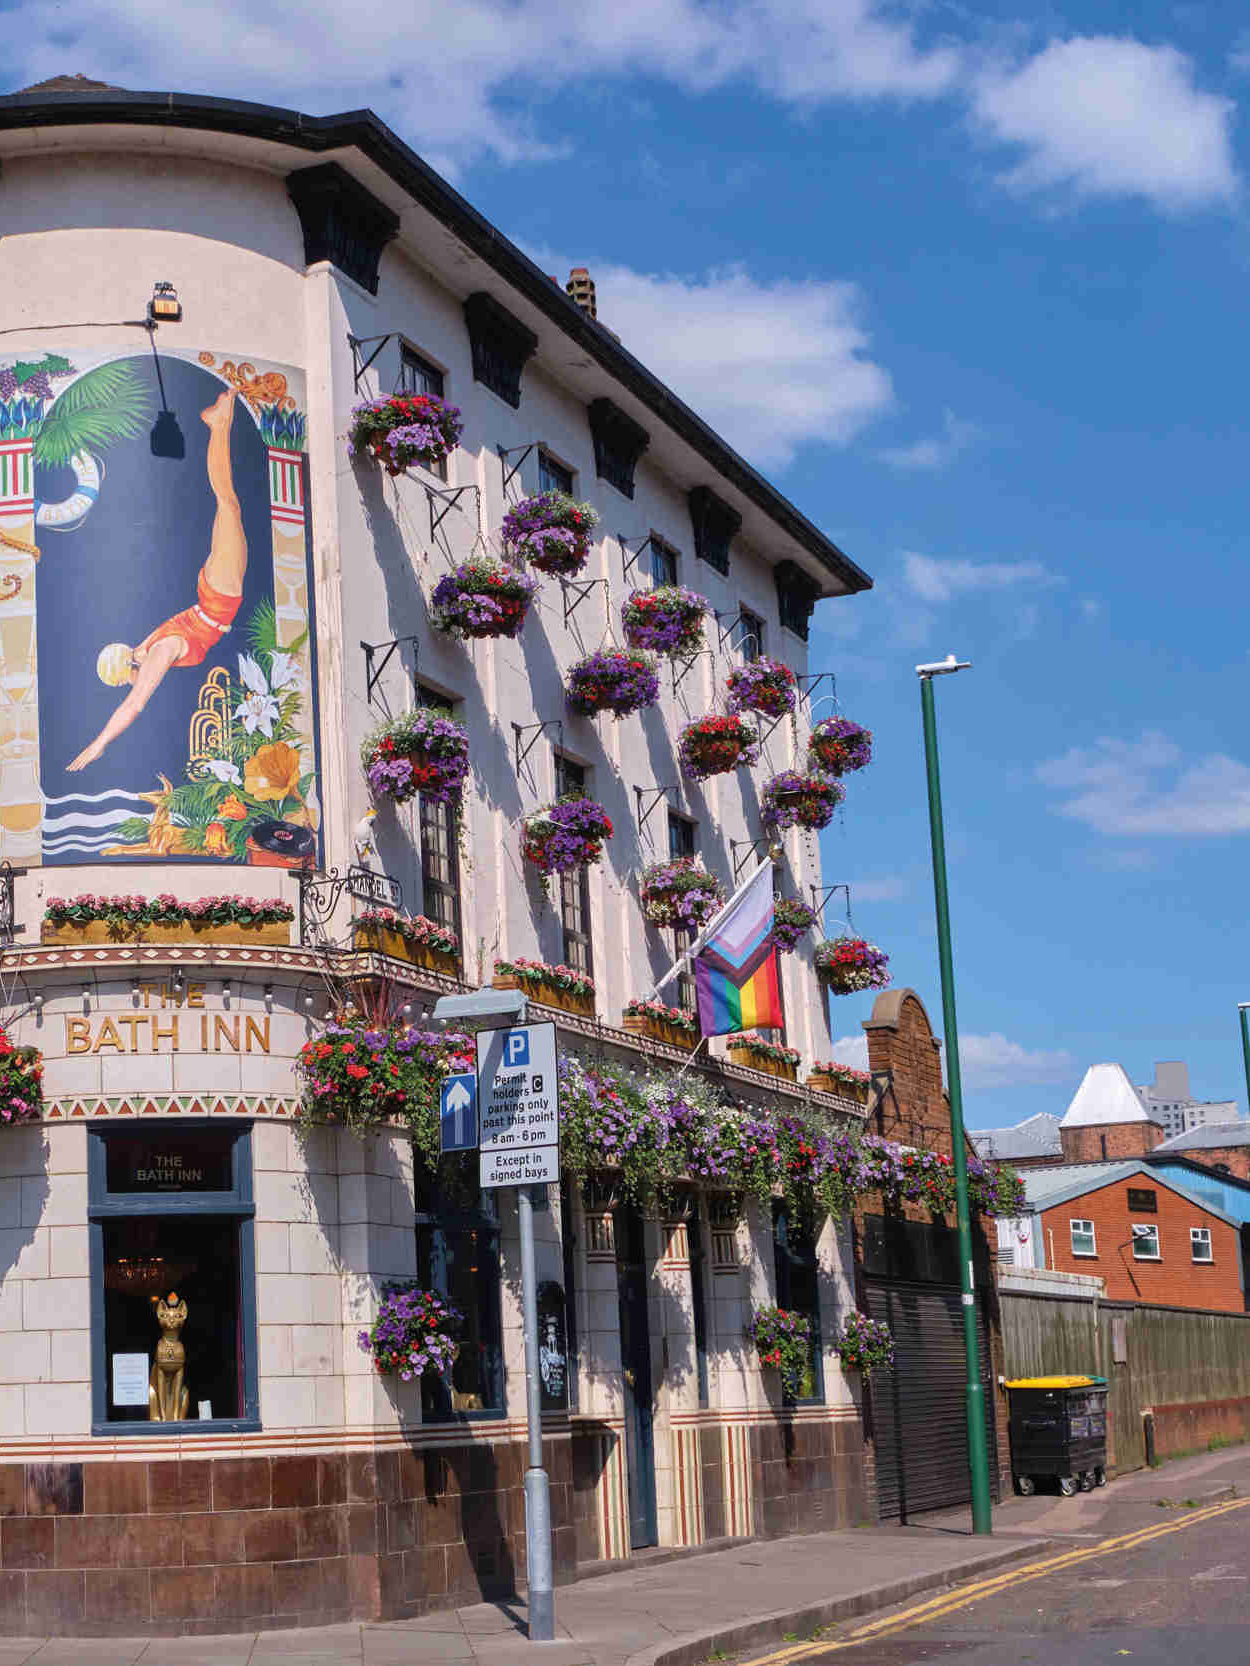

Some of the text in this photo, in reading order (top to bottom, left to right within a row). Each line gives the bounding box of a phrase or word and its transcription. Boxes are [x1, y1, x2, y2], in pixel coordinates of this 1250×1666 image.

[138, 983, 206, 1008] THE
[67, 1015, 271, 1054] BATH INN
[509, 1034, 525, 1064] P
[494, 1072, 527, 1088] Permit
[493, 1086, 530, 1100] holders
[488, 1098, 549, 1115] parking only
[483, 1111, 555, 1129] past this point
[492, 1133, 498, 1144] 8
[500, 1134, 515, 1143] am
[522, 1130, 528, 1141] 6
[531, 1130, 546, 1142] pm
[154, 1155, 182, 1167] THE
[495, 1152, 542, 1168] Except in
[137, 1168, 202, 1181] BATH INN
[489, 1166, 549, 1183] signed bays
